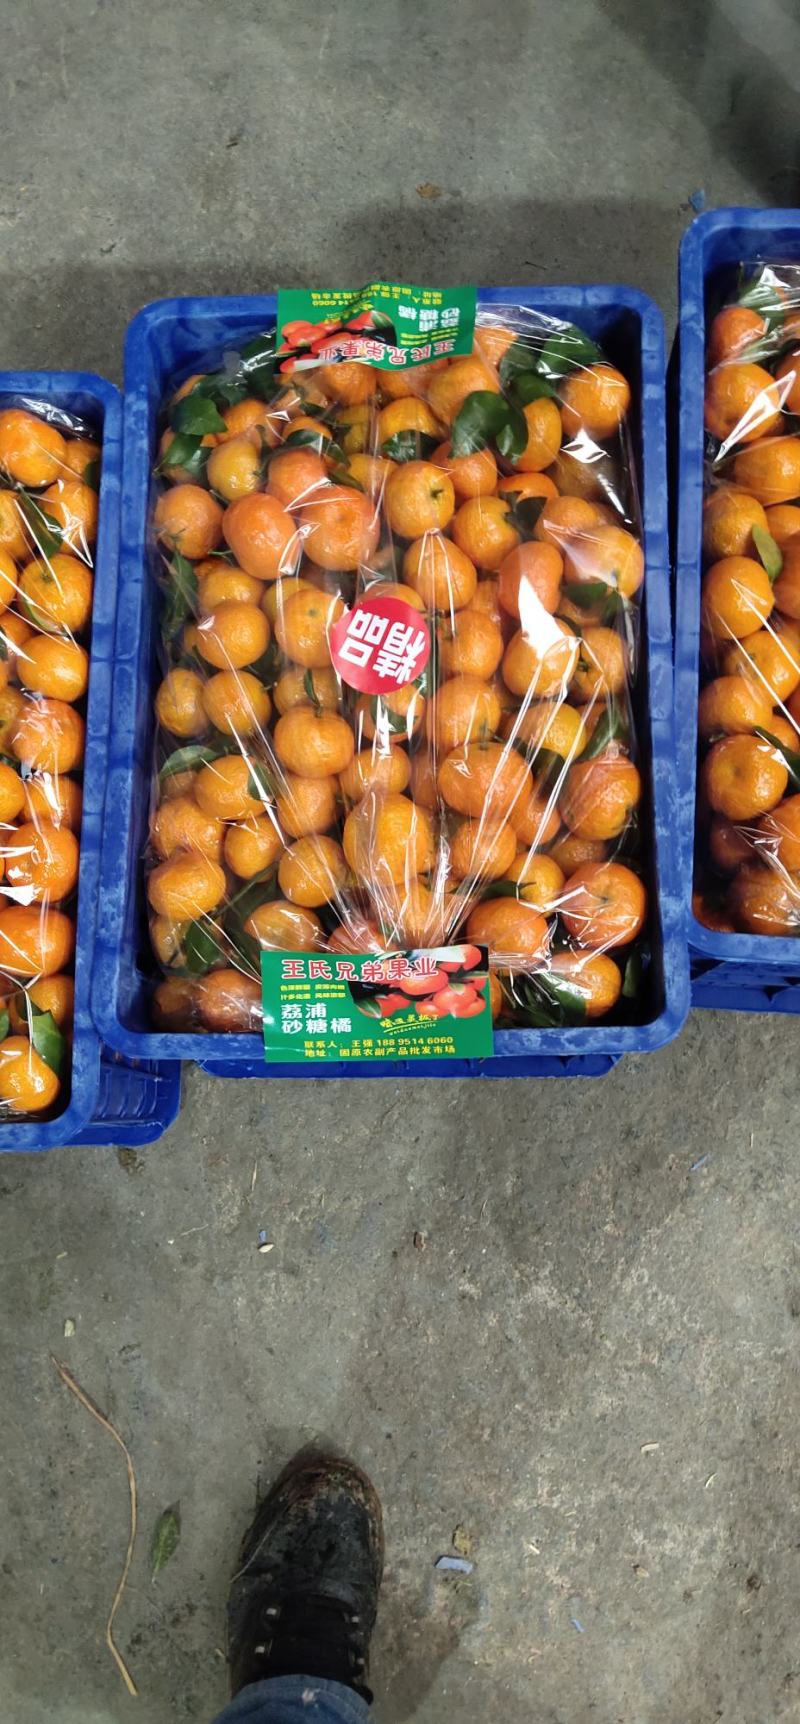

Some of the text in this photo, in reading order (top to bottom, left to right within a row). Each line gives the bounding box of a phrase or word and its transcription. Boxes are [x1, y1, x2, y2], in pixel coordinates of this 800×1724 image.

[319, 338, 458, 365] 王氏兄弟果业
[338, 608, 426, 685] 精品
[280, 956, 440, 983] 王氏兄弟果业
[280, 1002, 327, 1019] 荔浦
[281, 1017, 353, 1034] 砂糖橘
[339, 1044, 456, 1057] 固原农副产品批发市场
[351, 1039, 374, 1048] 王强
[376, 1039, 395, 1047] 188
[398, 1037, 424, 1046] 9514
[427, 1036, 454, 1044] 6060
